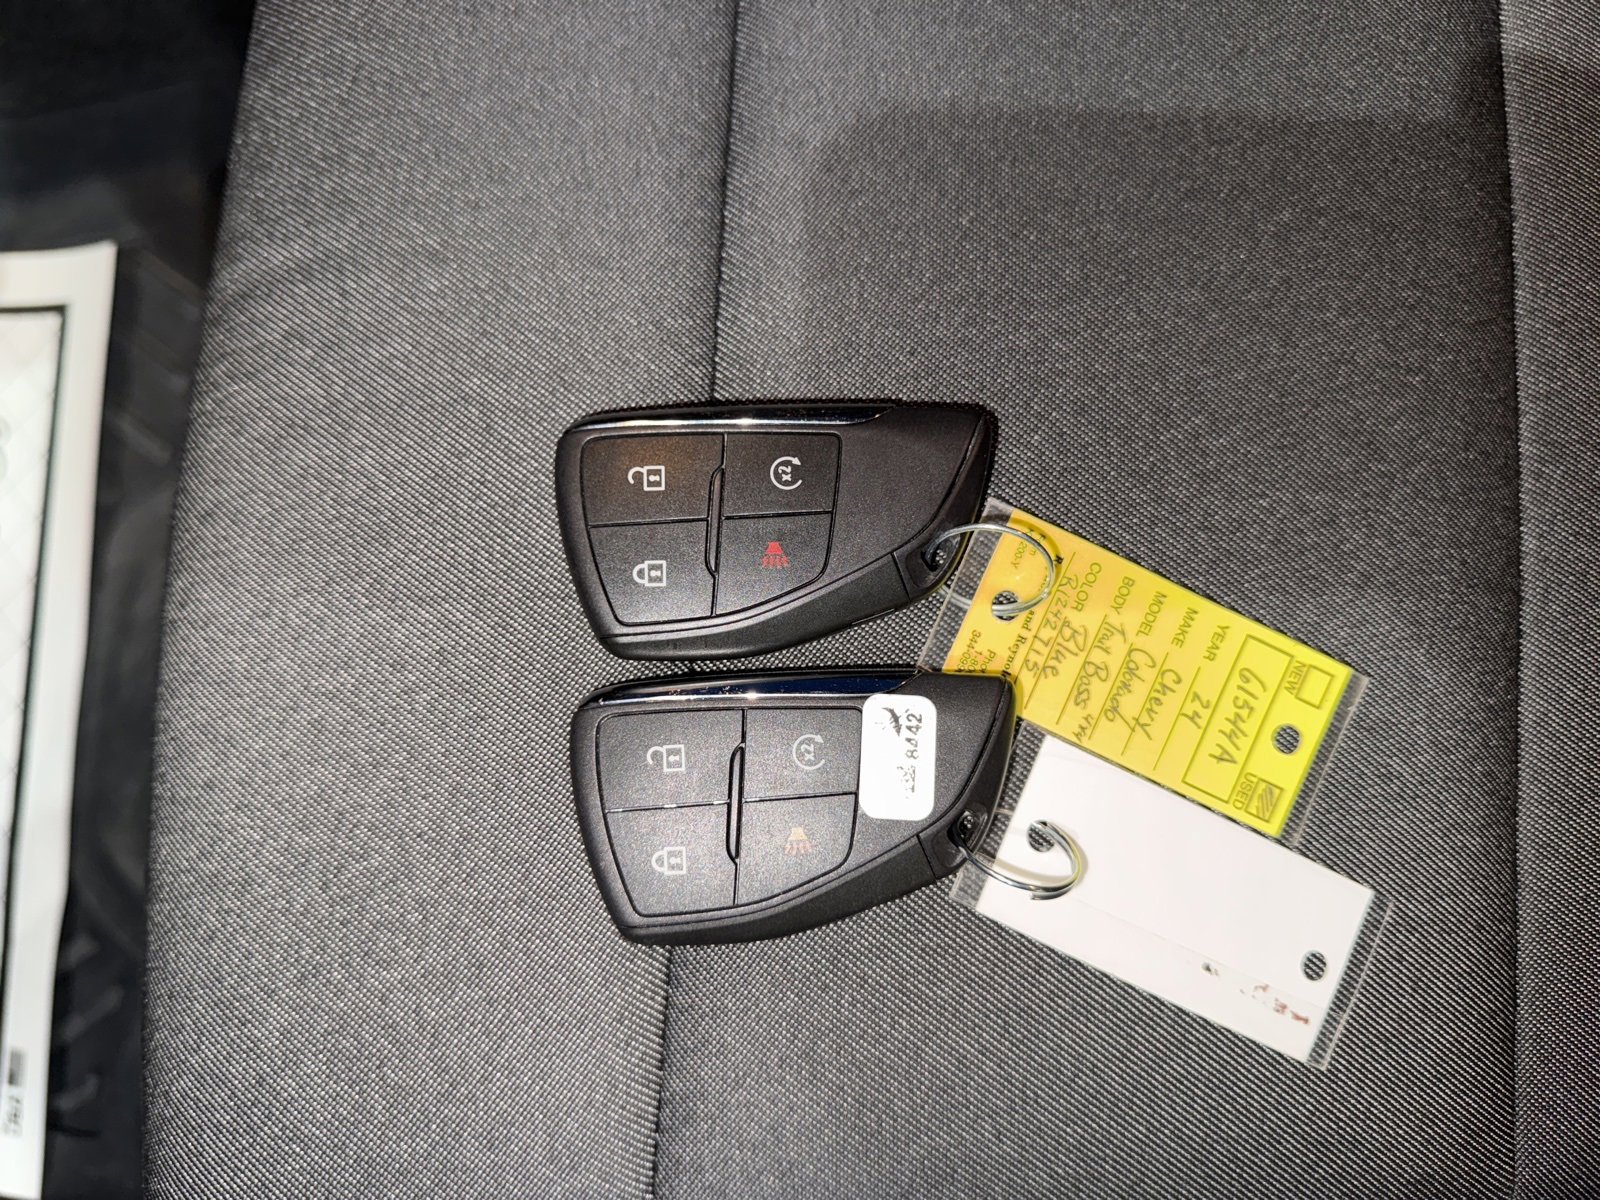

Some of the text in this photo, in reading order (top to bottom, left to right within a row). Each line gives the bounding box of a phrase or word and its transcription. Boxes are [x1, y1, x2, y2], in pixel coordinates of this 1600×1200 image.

[778, 465, 792, 482] x2
[1071, 562, 1102, 612] COLOR
[1110, 576, 1136, 615] BODY
[1021, 610, 1035, 631] and
[1136, 591, 1168, 637] MODEL
[1171, 607, 1199, 648] MAKE
[1043, 618, 1088, 680] Blue
[1094, 621, 1127, 655] Trail
[1203, 624, 1230, 662] YEAR
[1074, 660, 1109, 710] Boss
[1284, 660, 1306, 695] NEW
[1132, 668, 1182, 740] Chevy
[1179, 690, 1210, 730] 24
[1208, 667, 1267, 765] 61544A
[800, 743, 816, 761] x2
[1232, 772, 1257, 810] USED
